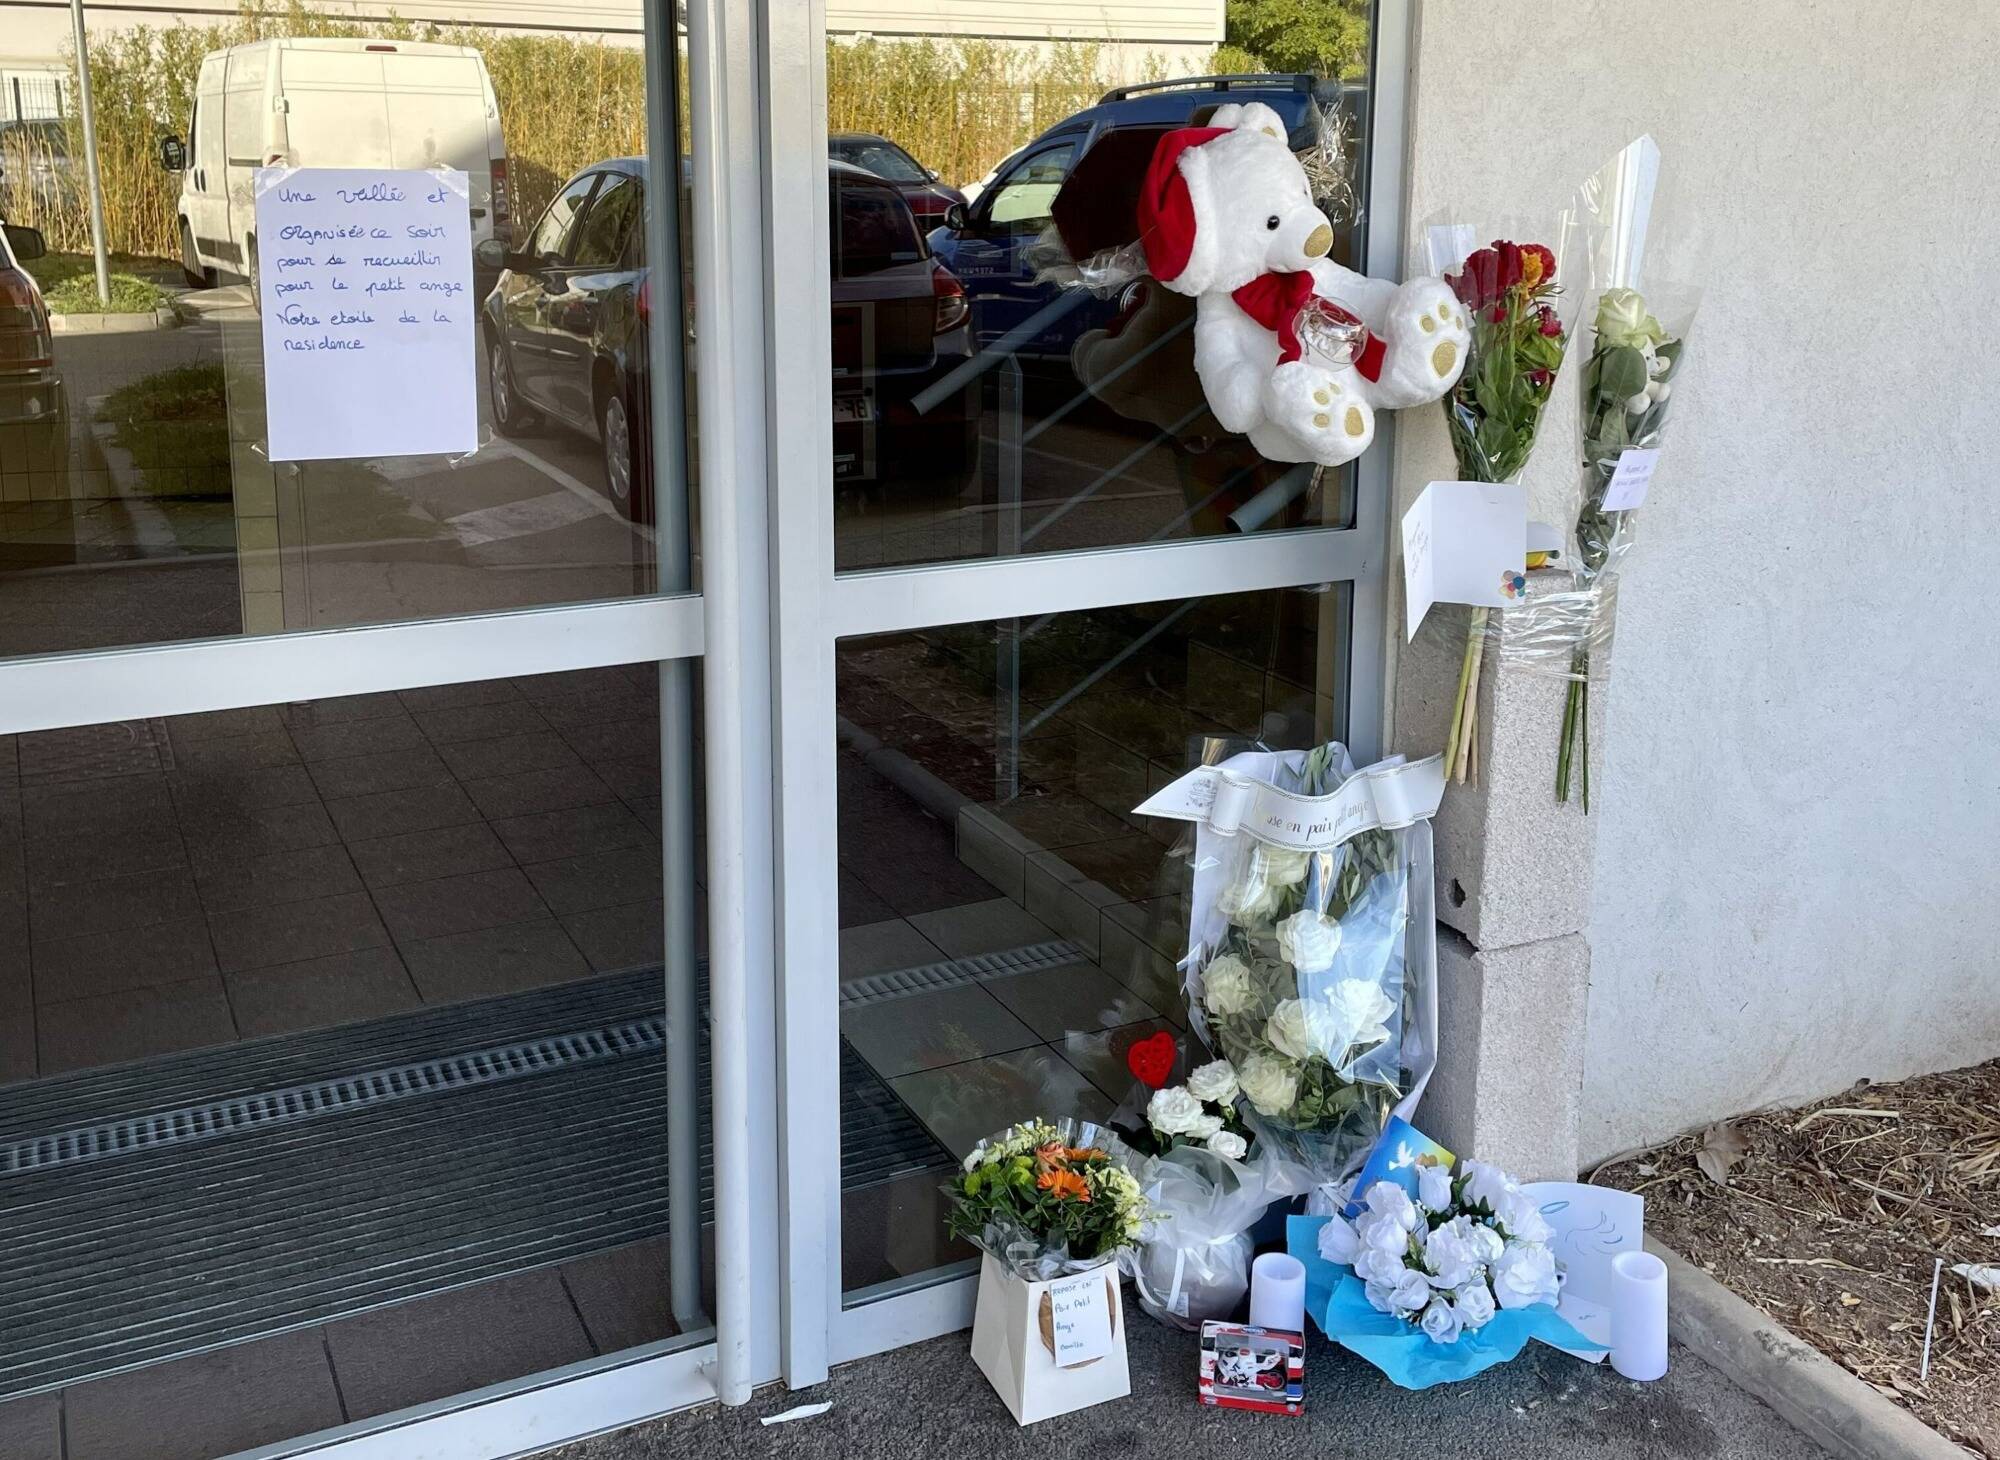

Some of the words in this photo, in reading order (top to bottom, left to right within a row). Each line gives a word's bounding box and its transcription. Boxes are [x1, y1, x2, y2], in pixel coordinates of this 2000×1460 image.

[278, 188, 317, 203] Une
[427, 187, 449, 203] et
[371, 228, 393, 239] ce
[276, 256, 315, 273] pour
[363, 251, 441, 267] recueillir
[275, 281, 314, 297] pour
[332, 277, 348, 290] le
[365, 276, 406, 296] petit
[420, 281, 464, 297] ange
[276, 304, 320, 325] Notre
[398, 309, 421, 323] de
[434, 309, 452, 323] la
